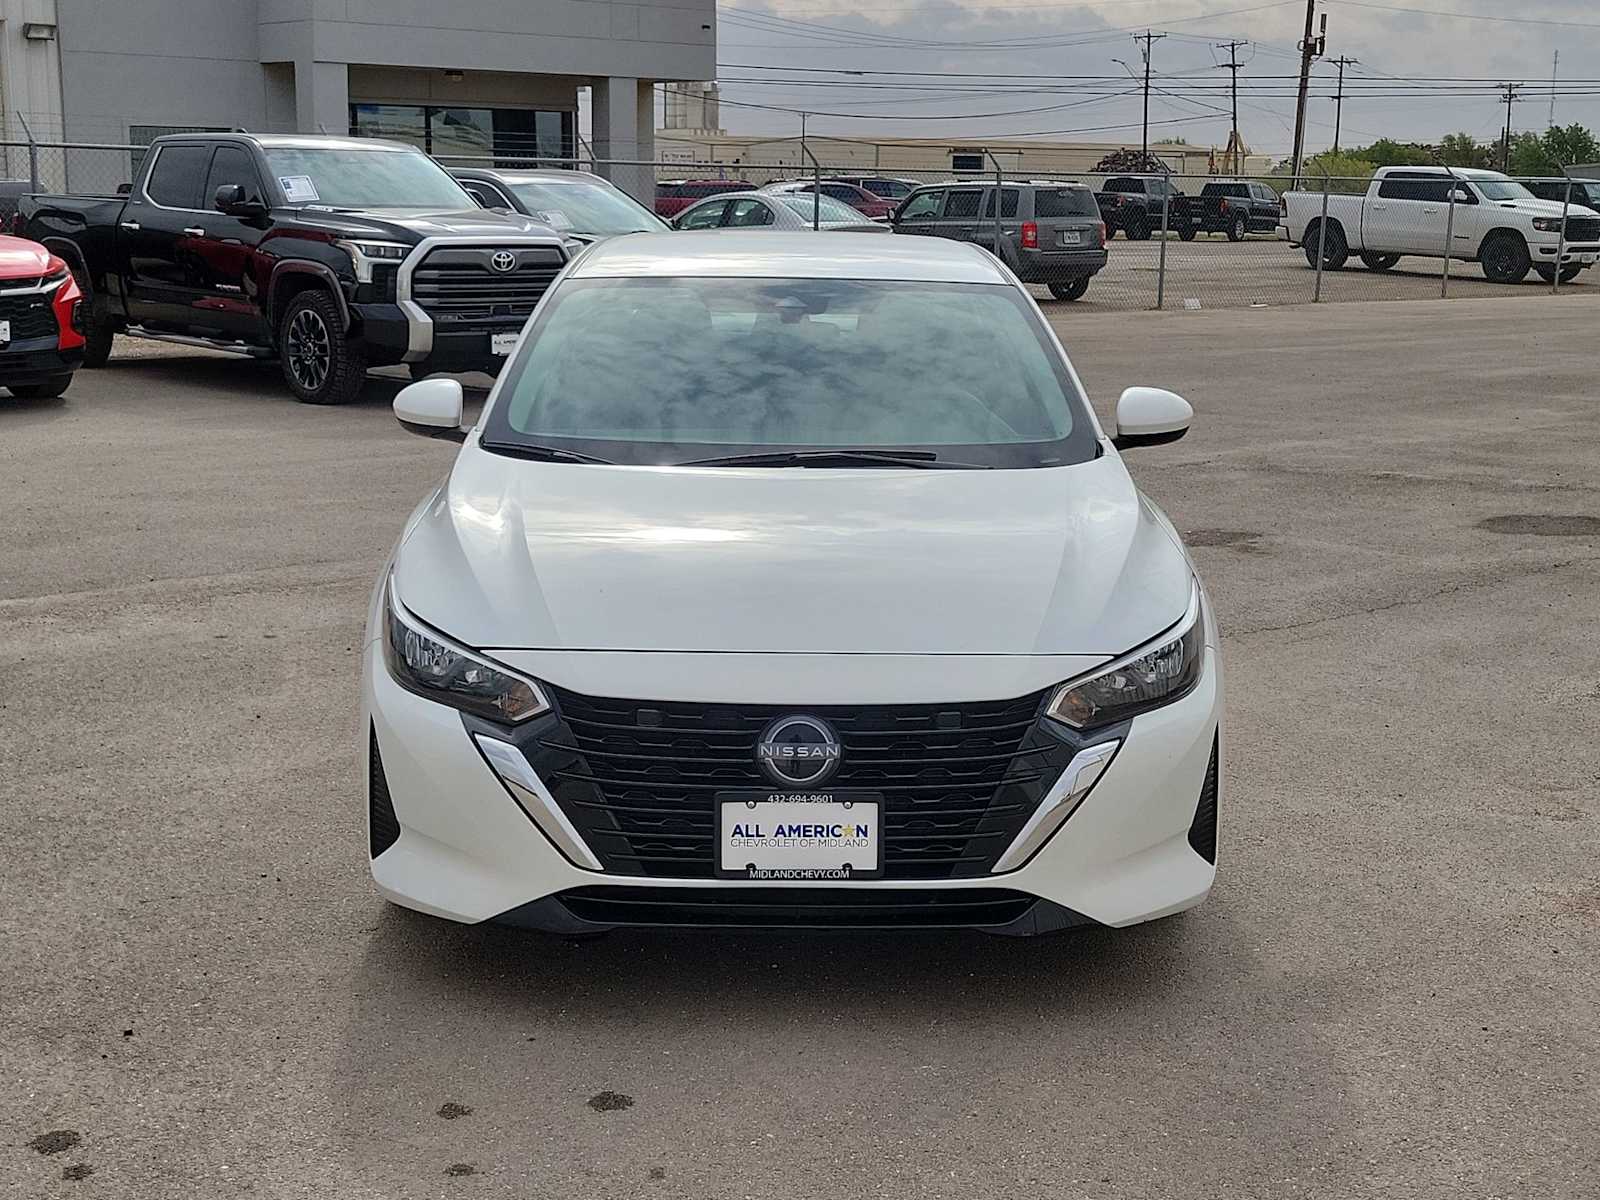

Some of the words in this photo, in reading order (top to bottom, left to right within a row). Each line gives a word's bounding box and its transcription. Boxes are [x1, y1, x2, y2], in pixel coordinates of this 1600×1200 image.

[760, 745, 838, 757] NISSAN
[767, 794, 833, 803] 432-694-9601
[731, 824, 765, 838] ALL
[774, 824, 868, 838] AMERICN
[730, 838, 797, 848] CHEVROLET
[799, 838, 815, 848] OF
[818, 838, 869, 848] MIDLAND
[749, 869, 850, 879] MIDLANDCHEVY.COM
